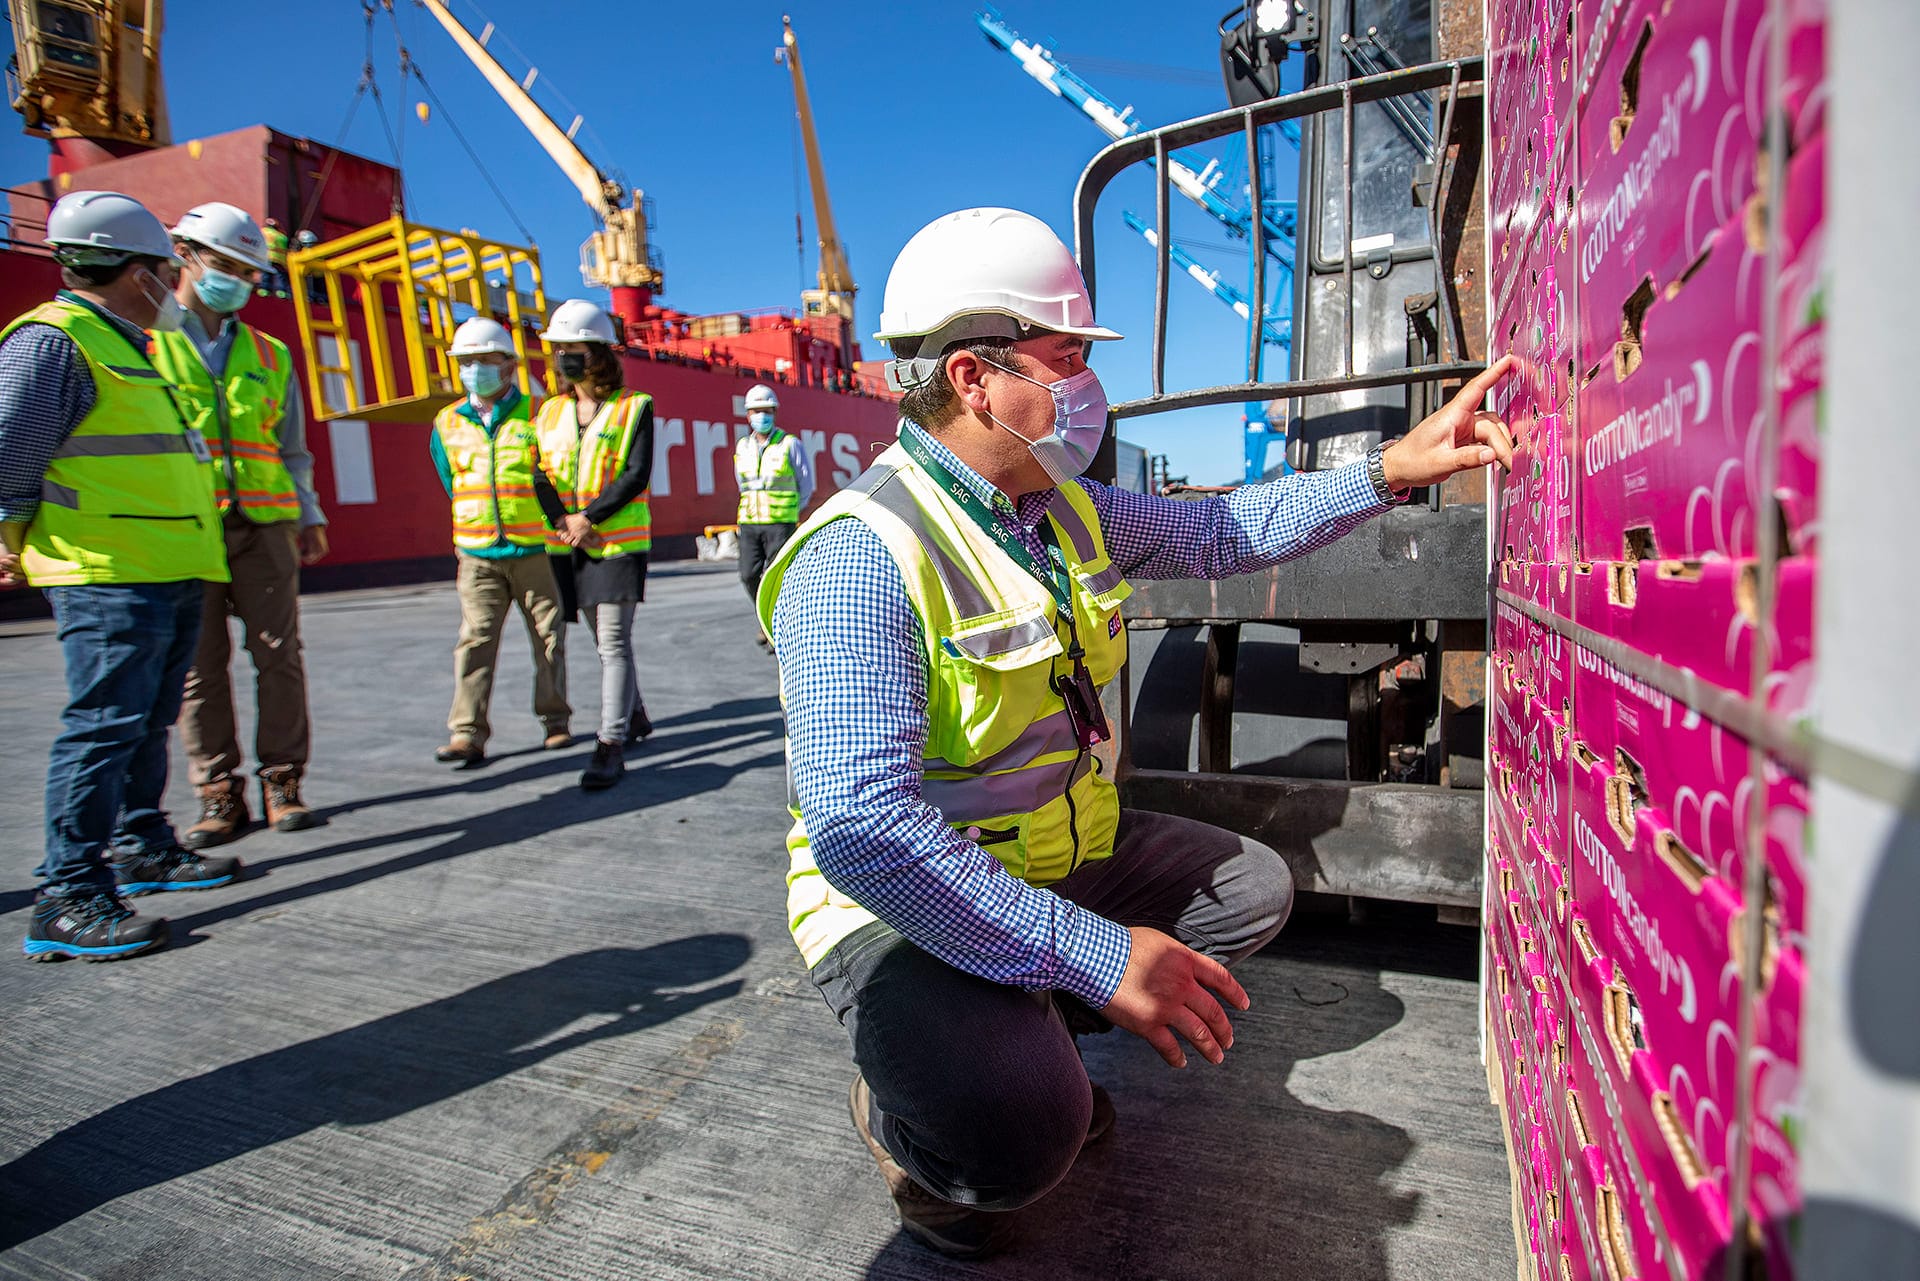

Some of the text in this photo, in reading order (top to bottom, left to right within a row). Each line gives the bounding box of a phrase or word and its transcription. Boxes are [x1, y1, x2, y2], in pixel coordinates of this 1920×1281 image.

[914, 446, 930, 466] SAG
[950, 482, 971, 504] SAG
[990, 522, 1009, 544] SAG
[1029, 561, 1046, 583] SAG
[1109, 616, 1122, 636] SAG
